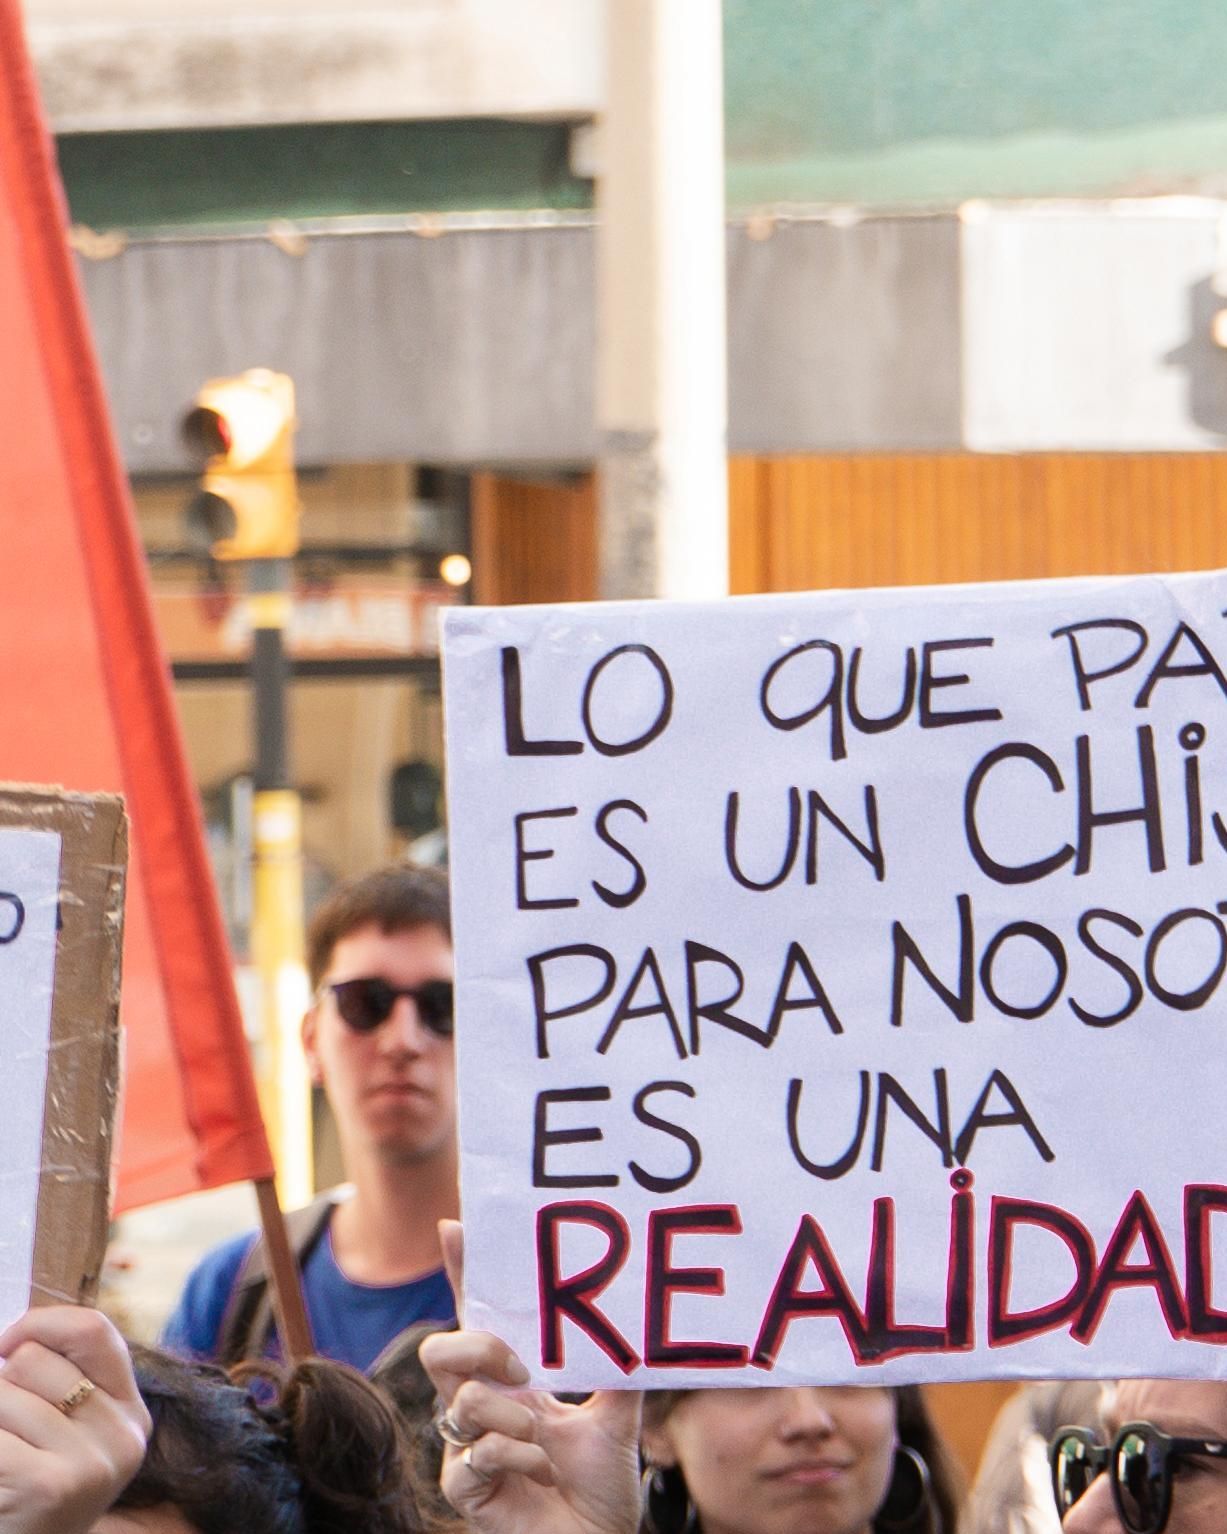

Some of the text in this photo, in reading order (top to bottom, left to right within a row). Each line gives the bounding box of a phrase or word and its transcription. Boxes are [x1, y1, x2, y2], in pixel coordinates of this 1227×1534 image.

[502, 645, 673, 756] LO
[515, 800, 647, 910] ES
[726, 785, 884, 891] UN
[527, 941, 843, 1059] PARA
[533, 1068, 1055, 1193] ES UNA
